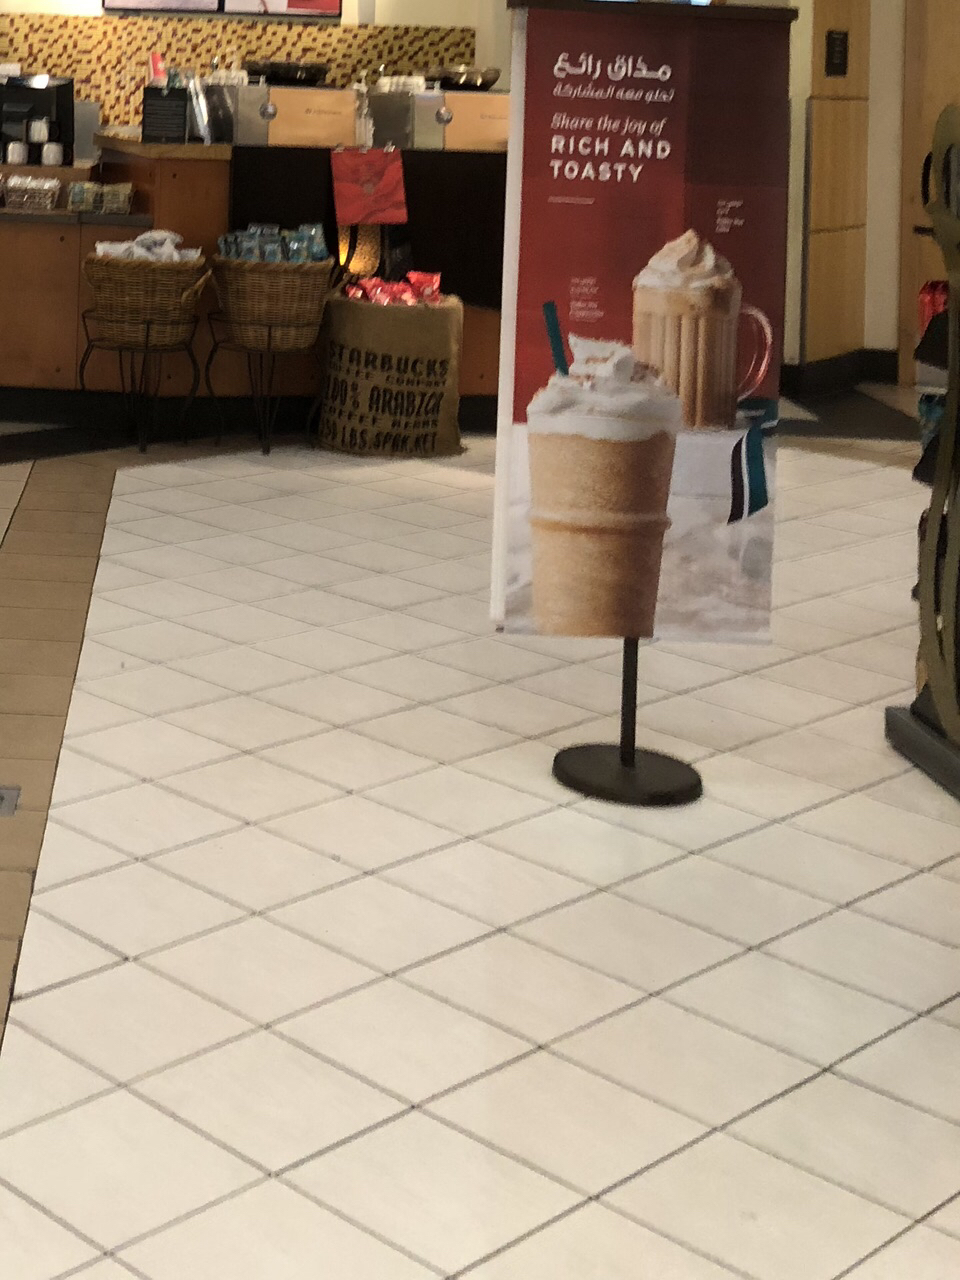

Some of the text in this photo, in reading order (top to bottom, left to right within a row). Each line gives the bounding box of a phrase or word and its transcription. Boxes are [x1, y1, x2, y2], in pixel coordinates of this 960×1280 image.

[553, 52, 672, 82] مذاق رائع
[551, 112, 669, 137] Share the joy of
[551, 134, 672, 160] RICH AND
[549, 158, 644, 184] TOASTY
[328, 340, 450, 379] STARBUCKS
